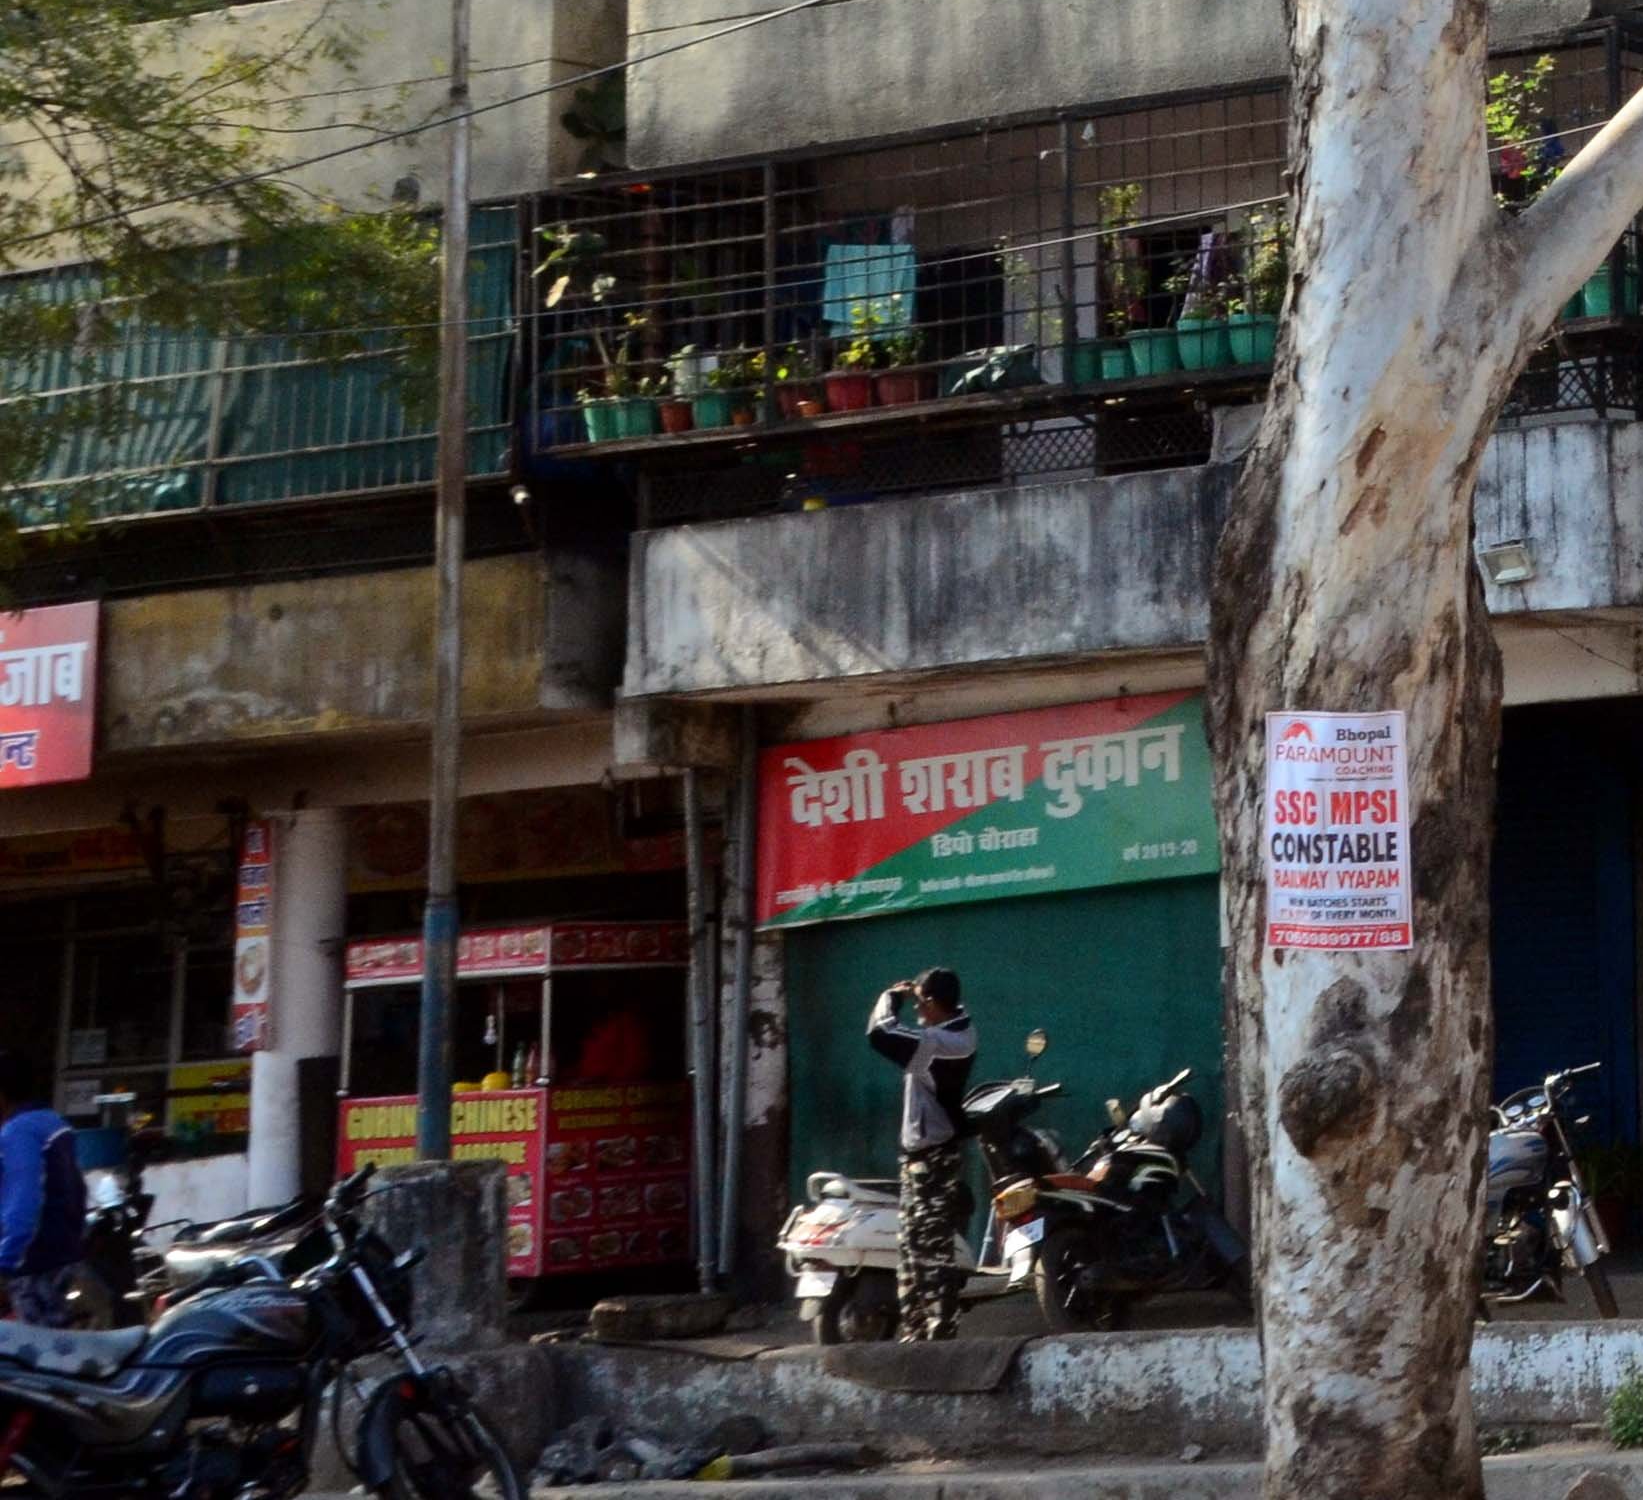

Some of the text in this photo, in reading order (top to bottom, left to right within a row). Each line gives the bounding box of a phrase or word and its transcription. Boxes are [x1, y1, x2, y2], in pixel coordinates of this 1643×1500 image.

[0, 641, 88, 706] जाब
[1336, 726, 1391, 743] Bhopal
[1275, 744, 1398, 764] PARAMOUNT
[785, 724, 1184, 828] देशी शराब दुकान
[1335, 765, 1393, 775] COACHING
[1274, 789, 1397, 825] SSC MPSI
[931, 827, 1039, 858] डिपो चौराहा
[1271, 831, 1398, 864] CONSTABLE
[1274, 869, 1400, 889] RAILWAY VYAPAM
[1325, 910, 1356, 919] EVERY
[1359, 909, 1397, 919] MONTH
[1351, 896, 1388, 907] STARTS
[451, 1098, 537, 1135] CHINESE
